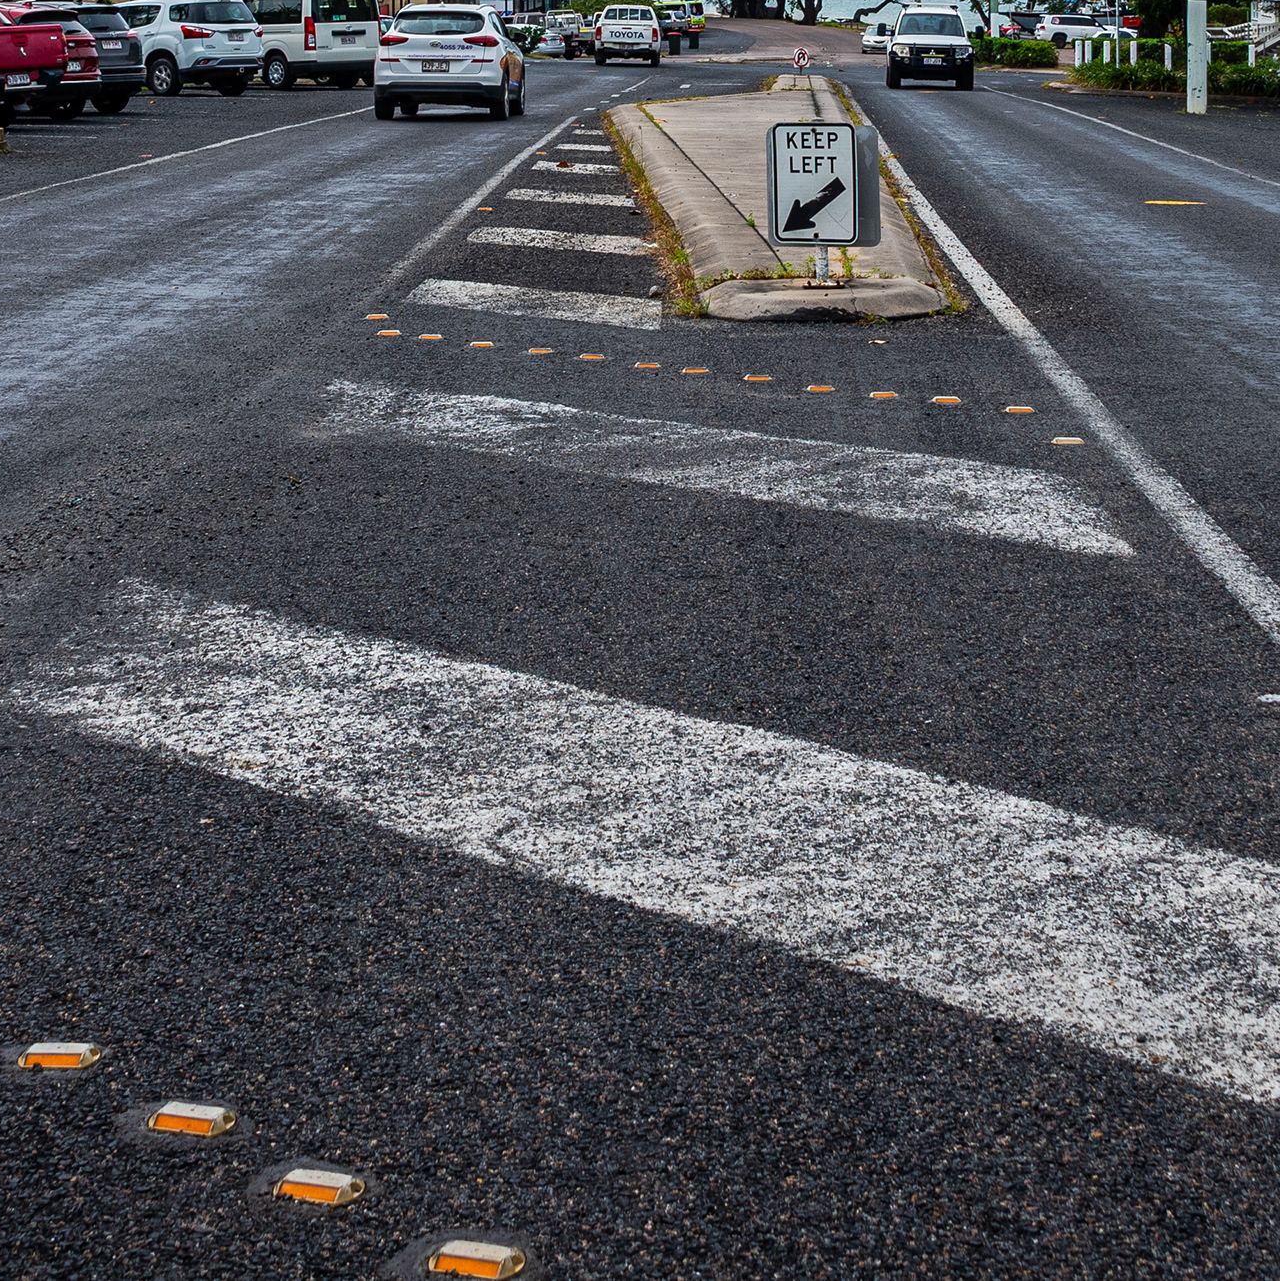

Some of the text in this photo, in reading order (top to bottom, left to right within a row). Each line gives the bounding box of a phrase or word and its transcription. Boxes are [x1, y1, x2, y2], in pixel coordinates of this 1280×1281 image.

[609, 31, 645, 39] TOYOTA
[786, 131, 838, 149] KEEP
[789, 156, 837, 174] LEFT
